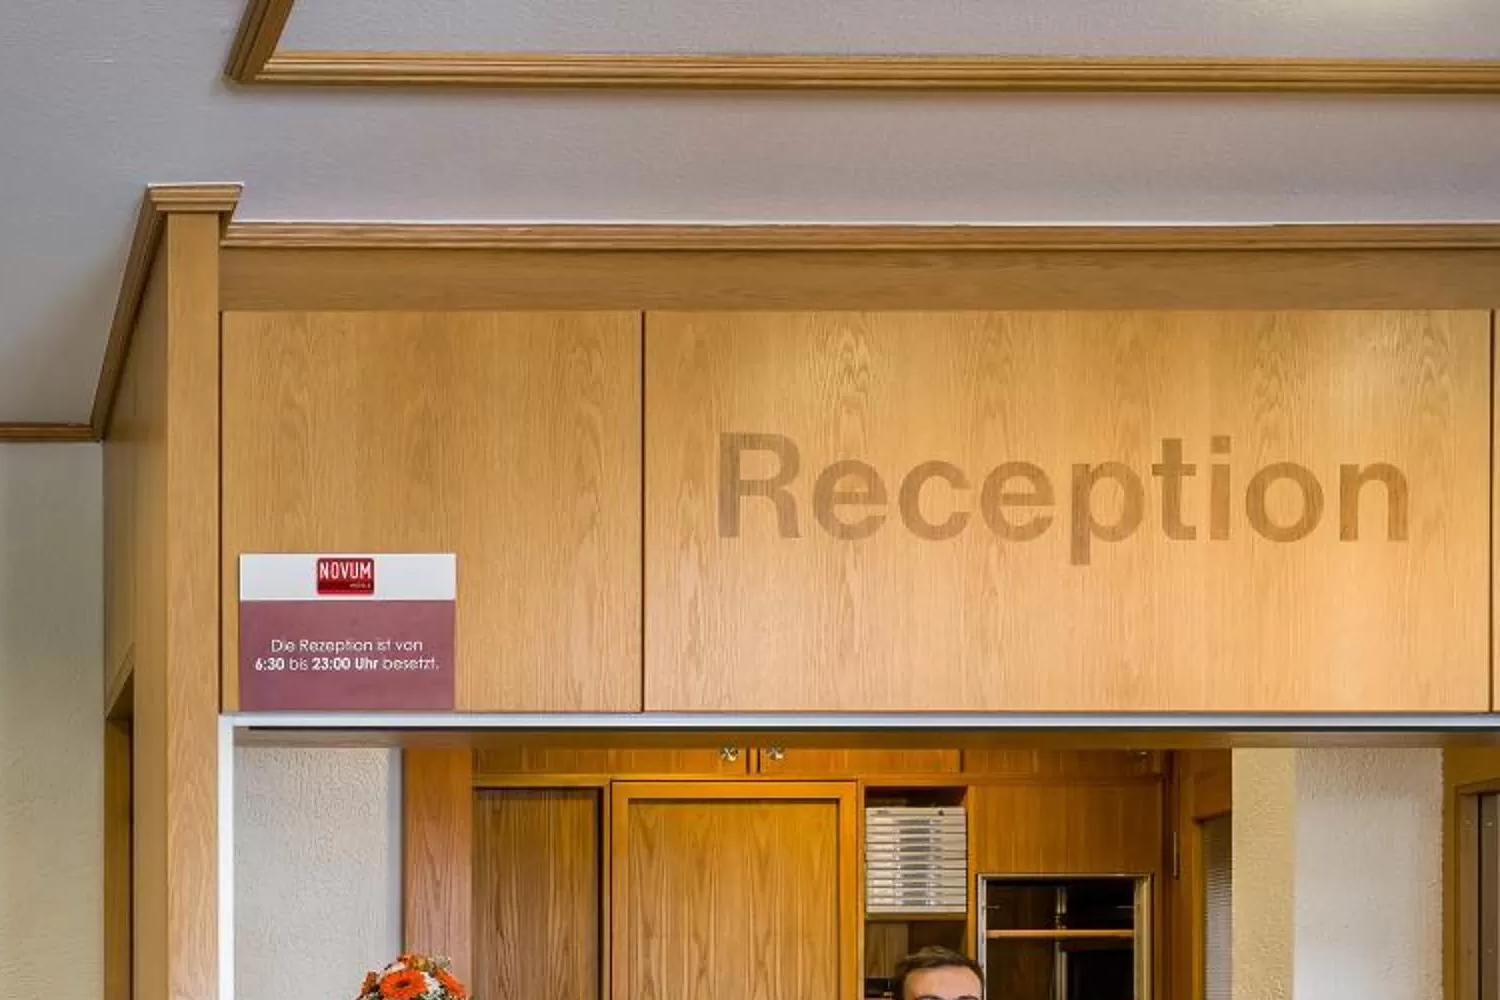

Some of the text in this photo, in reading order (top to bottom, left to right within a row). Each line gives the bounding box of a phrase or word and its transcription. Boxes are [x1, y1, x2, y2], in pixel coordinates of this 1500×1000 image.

[717, 431, 1409, 566] Reception
[319, 561, 372, 579] NOVUM
[270, 637, 423, 654] Die Rezeption ist von
[255, 657, 440, 671] 6:30 bis 23:00 Uhr besetzt.
